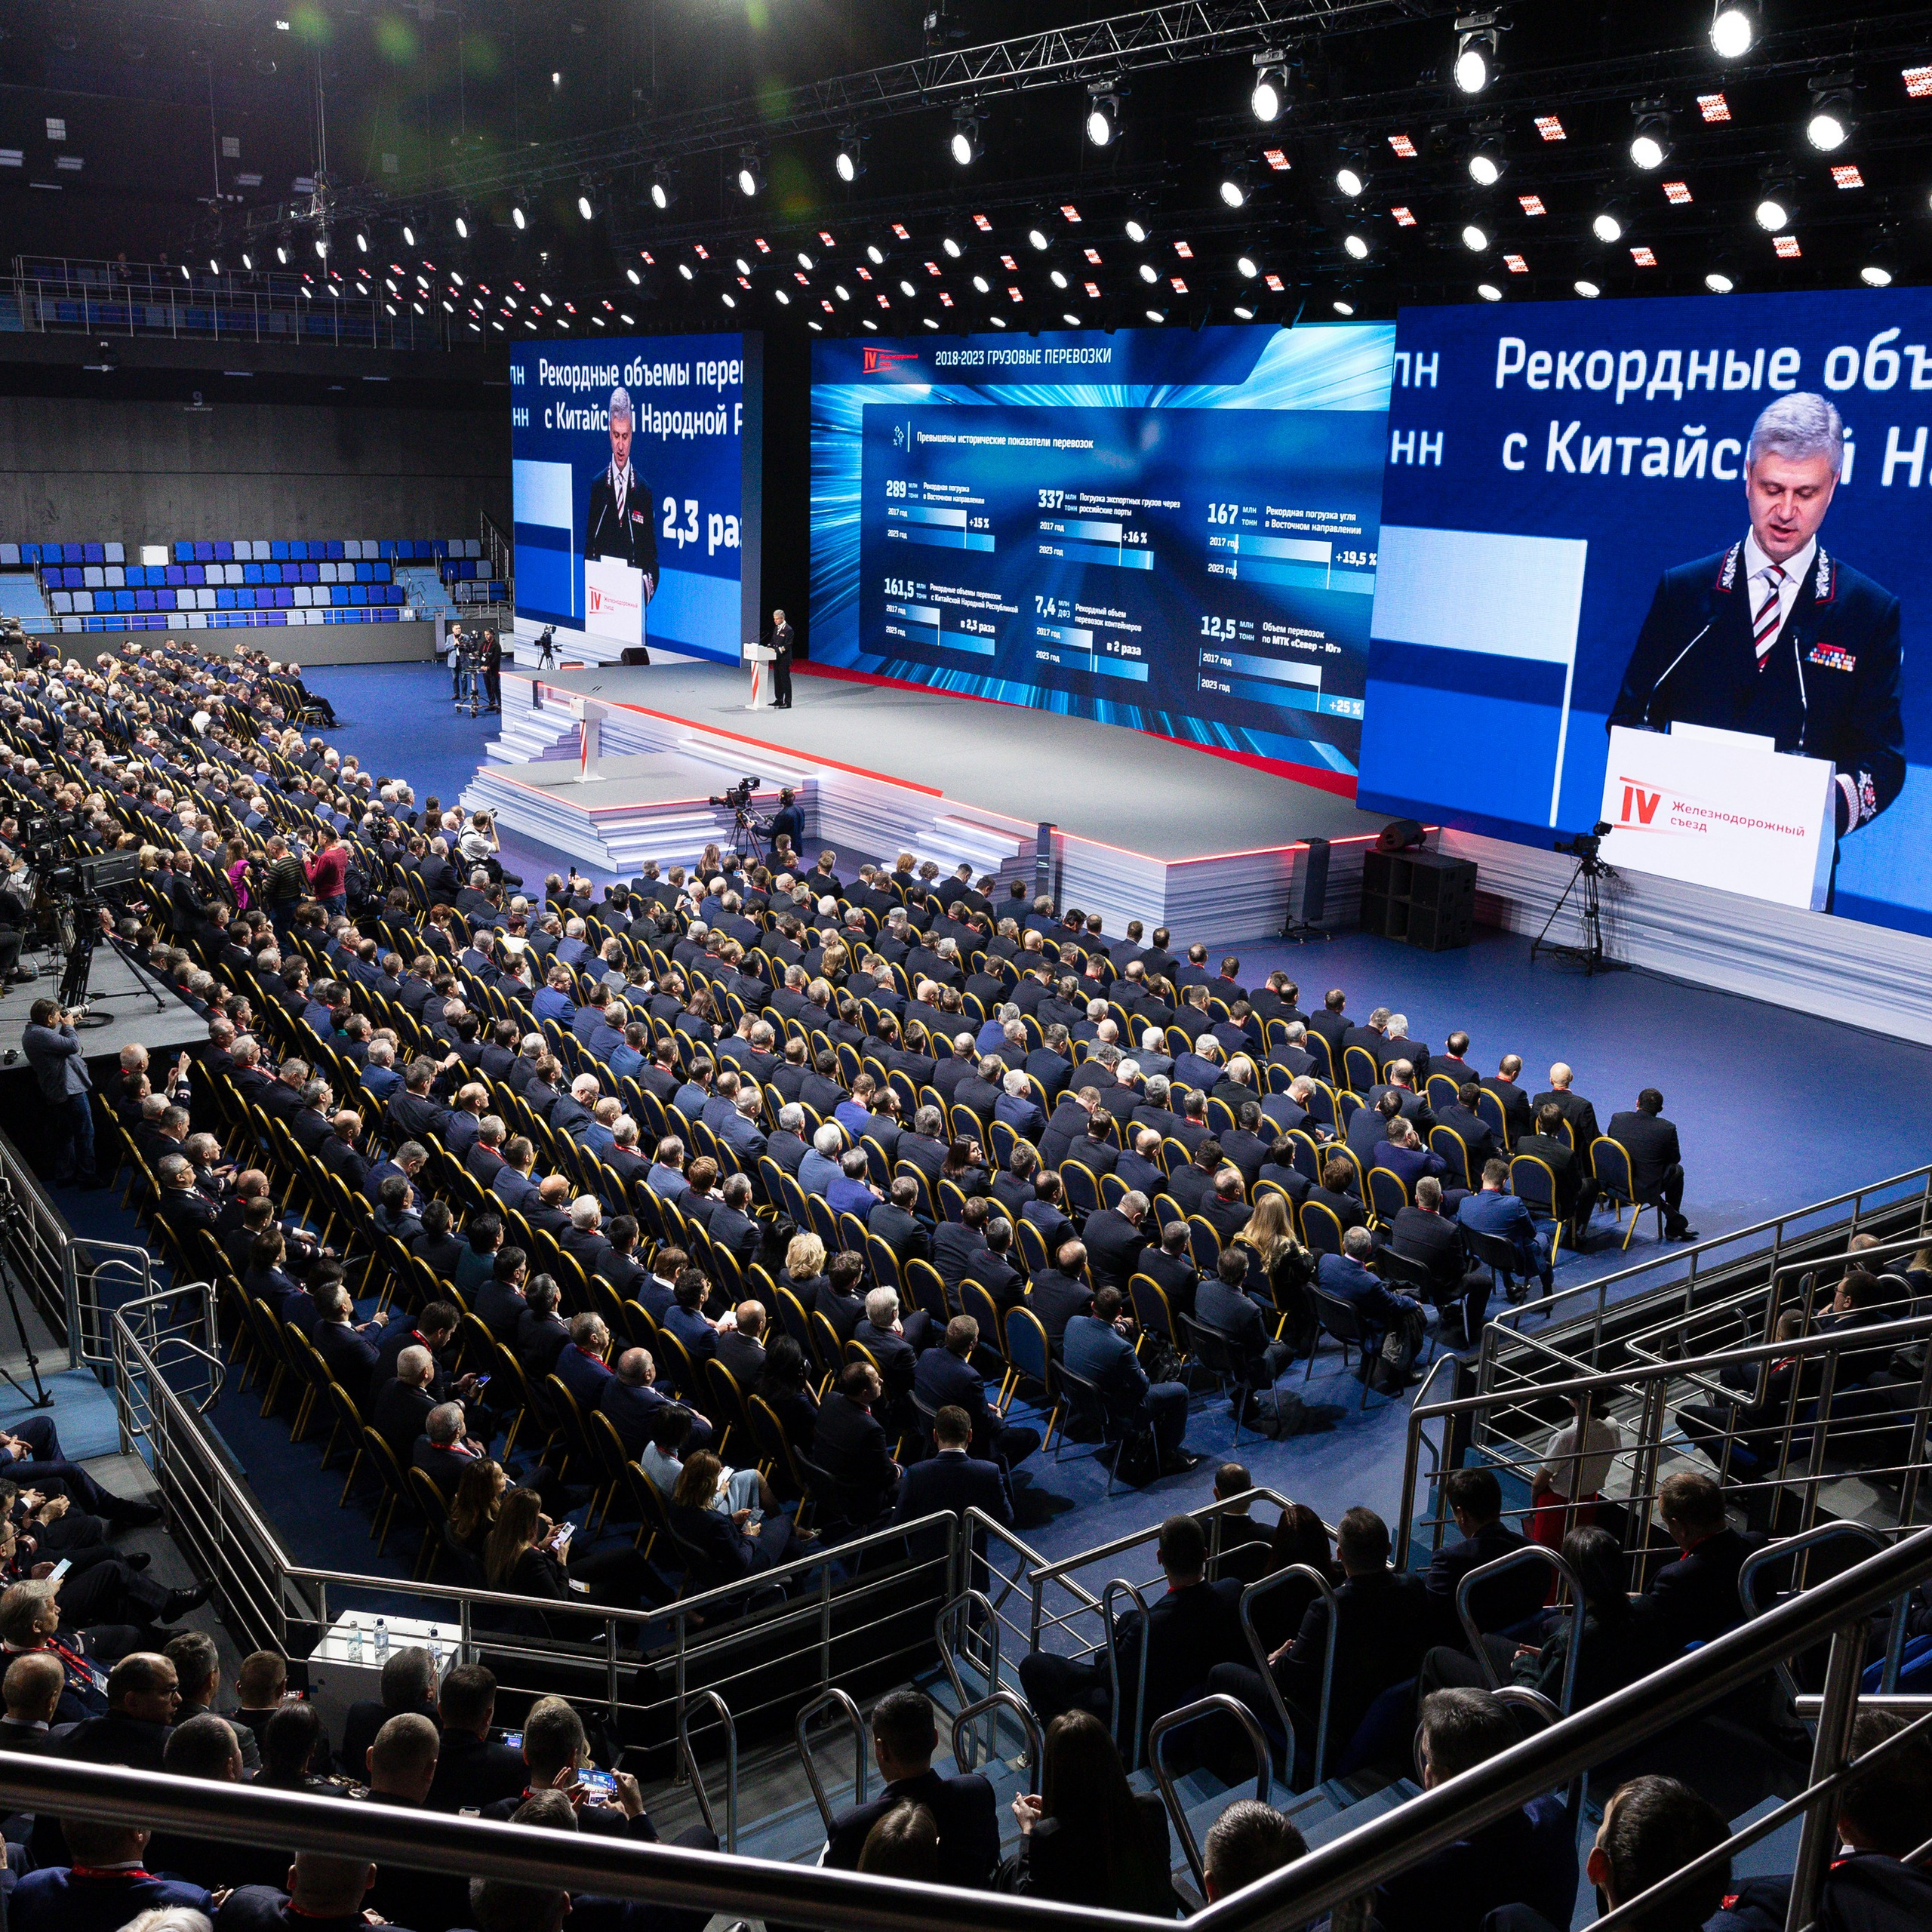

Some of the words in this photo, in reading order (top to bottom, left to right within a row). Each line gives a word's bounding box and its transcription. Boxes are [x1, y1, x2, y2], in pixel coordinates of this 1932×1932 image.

[865, 351, 877, 369] IV
[935, 350, 985, 365] 2018-2023
[987, 349, 1041, 365] ГРУЗОВЫЕ
[1044, 348, 1112, 364] ПЕРЕВОЗКИ
[539, 358, 619, 393] Рекордные
[624, 355, 689, 386] объемы
[697, 359, 743, 393] пере
[1496, 337, 1801, 404] Рекордные
[545, 408, 552, 429] с
[642, 403, 727, 441] Народной
[917, 432, 956, 444] Превышены
[958, 435, 1006, 446] исторические
[1008, 437, 1051, 447] показатели
[1053, 438, 1094, 451] перевозок
[1503, 432, 1527, 471] с
[1881, 426, 1932, 488] Н
[886, 480, 906, 498] 289
[1038, 489, 1064, 508] 337
[1079, 493, 1106, 503] Погрузка
[1106, 496, 1140, 506] экспортных
[1142, 499, 1161, 508] грузов
[1163, 500, 1180, 509] через
[900, 509, 908, 518] год
[1079, 506, 1113, 515] российские
[1114, 509, 1132, 517] порты
[1208, 503, 1238, 525] 167
[1266, 506, 1304, 518] Рекордная
[1306, 511, 1338, 521] погрузка
[1340, 512, 1356, 522] угля
[663, 497, 699, 549] 2,3
[708, 513, 742, 556] ра
[969, 517, 983, 528] +15
[983, 518, 989, 528] %
[1040, 521, 1054, 531] 2017
[1054, 524, 1065, 532] год
[1241, 518, 1257, 527] тонн
[1271, 519, 1310, 531] Восточном
[1312, 523, 1362, 535] направлении
[888, 529, 899, 538] 2023
[900, 531, 908, 540] год
[1122, 531, 1140, 543] +16
[1140, 532, 1147, 544] %
[1038, 545, 1053, 555] 2023
[1054, 548, 1063, 557] год
[1209, 537, 1226, 546] 2017
[1226, 539, 1239, 549] год
[1335, 550, 1367, 567] +19,5
[1368, 553, 1377, 566] %
[1208, 563, 1225, 574] 2023
[1226, 566, 1238, 577] год
[884, 578, 915, 599] 161,5
[591, 591, 601, 610] IV
[1035, 595, 1056, 618] 7,4
[886, 605, 897, 614] 2017
[898, 607, 906, 615] год
[1057, 609, 1071, 618] ДФЭ
[1075, 603, 1107, 616] Рекордный
[1107, 608, 1127, 618] объем
[885, 625, 897, 635] 2023
[897, 628, 906, 637] год
[960, 620, 965, 628] в
[966, 619, 978, 632] 2,3
[979, 623, 995, 634] раза
[1075, 616, 1104, 626] перевозок
[1104, 620, 1142, 632] контейнеров
[1201, 616, 1236, 641] 12,5
[1239, 620, 1254, 629] млн
[1263, 621, 1287, 634] Объем
[1287, 626, 1324, 639] перевозок
[1036, 626, 1050, 636] 2017
[1051, 630, 1061, 639] год
[1238, 632, 1254, 641] тонн
[1106, 641, 1112, 651] в
[1113, 641, 1120, 652] 2
[1121, 645, 1142, 656] раза
[1272, 636, 1290, 647] МТК
[1291, 640, 1317, 653] «Север
[1325, 643, 1342, 654] Юг»
[1035, 650, 1050, 660] 2023
[1050, 654, 1060, 663] год
[1202, 653, 1220, 663] 2017
[1220, 657, 1232, 667] год
[1201, 678, 1217, 690] 2023
[1218, 683, 1231, 694] год
[1329, 699, 1350, 714] +25
[1352, 702, 1361, 715] %
[1620, 785, 1661, 824] IV
[1670, 817, 1707, 833] съезд
[1672, 801, 1805, 837] Железнодорожный
